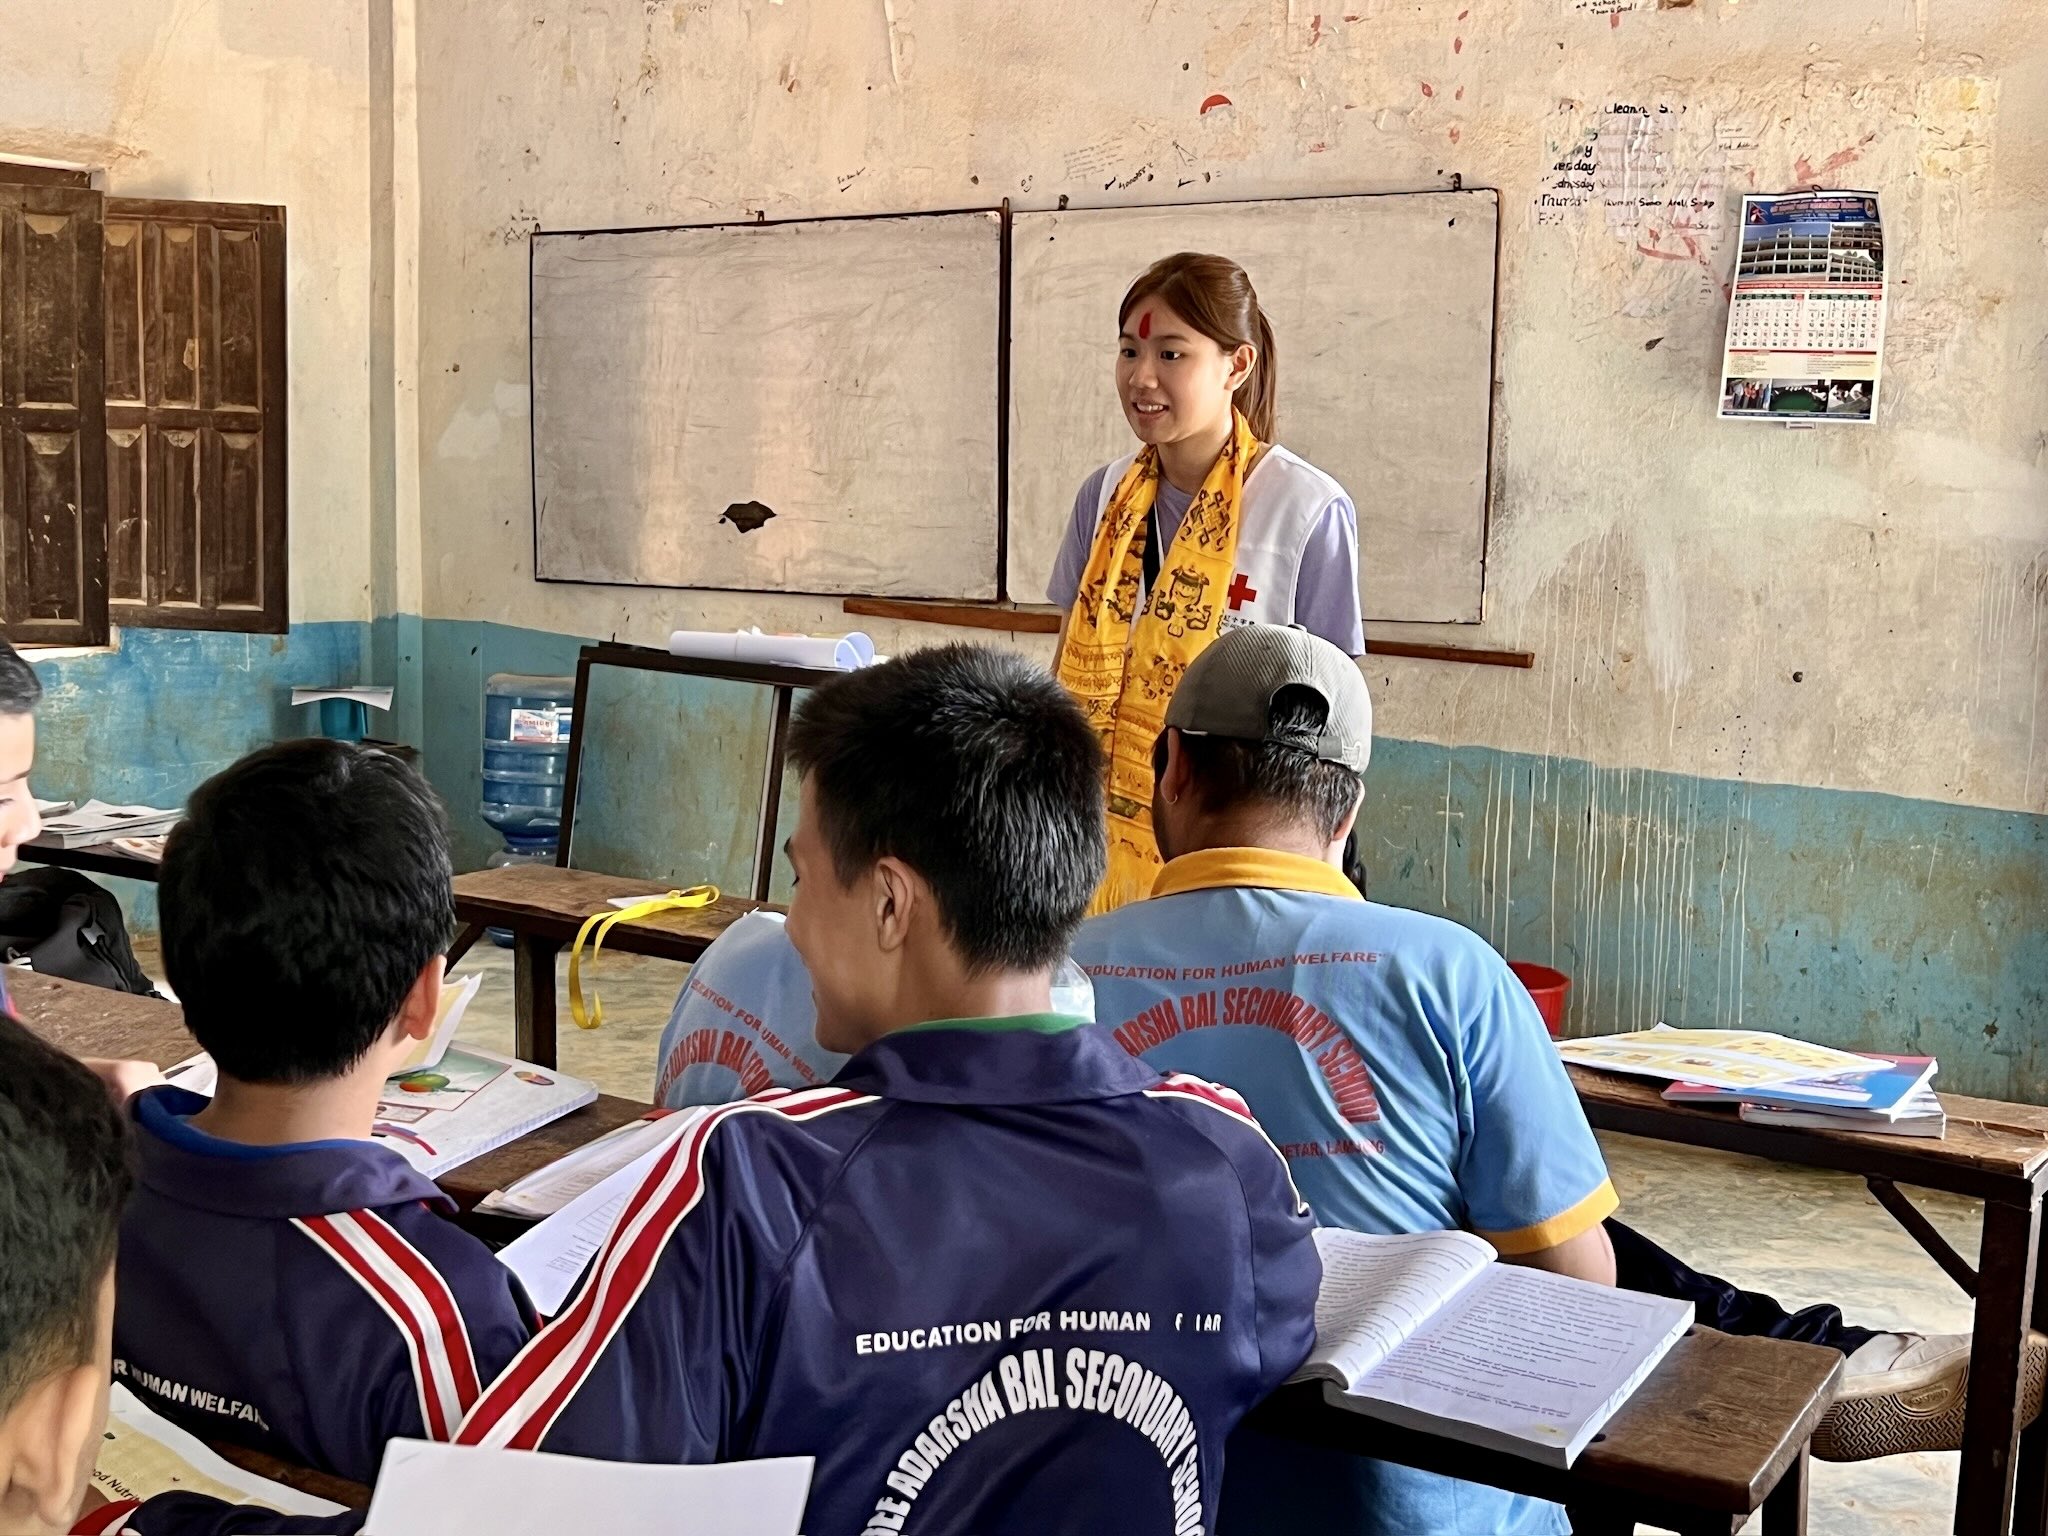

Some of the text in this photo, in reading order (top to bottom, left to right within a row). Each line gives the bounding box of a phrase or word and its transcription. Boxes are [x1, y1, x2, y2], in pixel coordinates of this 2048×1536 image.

[1084, 964, 1177, 981] EDUCATION
[1182, 967, 1216, 981] FOR
[1221, 957, 1286, 978] HUMAN
[1112, 998, 1182, 1057] ARSHA
[1180, 990, 1218, 1031] BAL
[1223, 986, 1342, 1052] SECONDARY
[856, 1319, 1002, 1355] EDUCATION
[1009, 1311, 1051, 1339] FOR
[1060, 1310, 1151, 1332] HUMAN
[190, 1387, 270, 1432] WELFA
[886, 1370, 1007, 1500] ADARSHA
[999, 1348, 1060, 1414] BAL
[1064, 1346, 1197, 1468] SECONDARY
